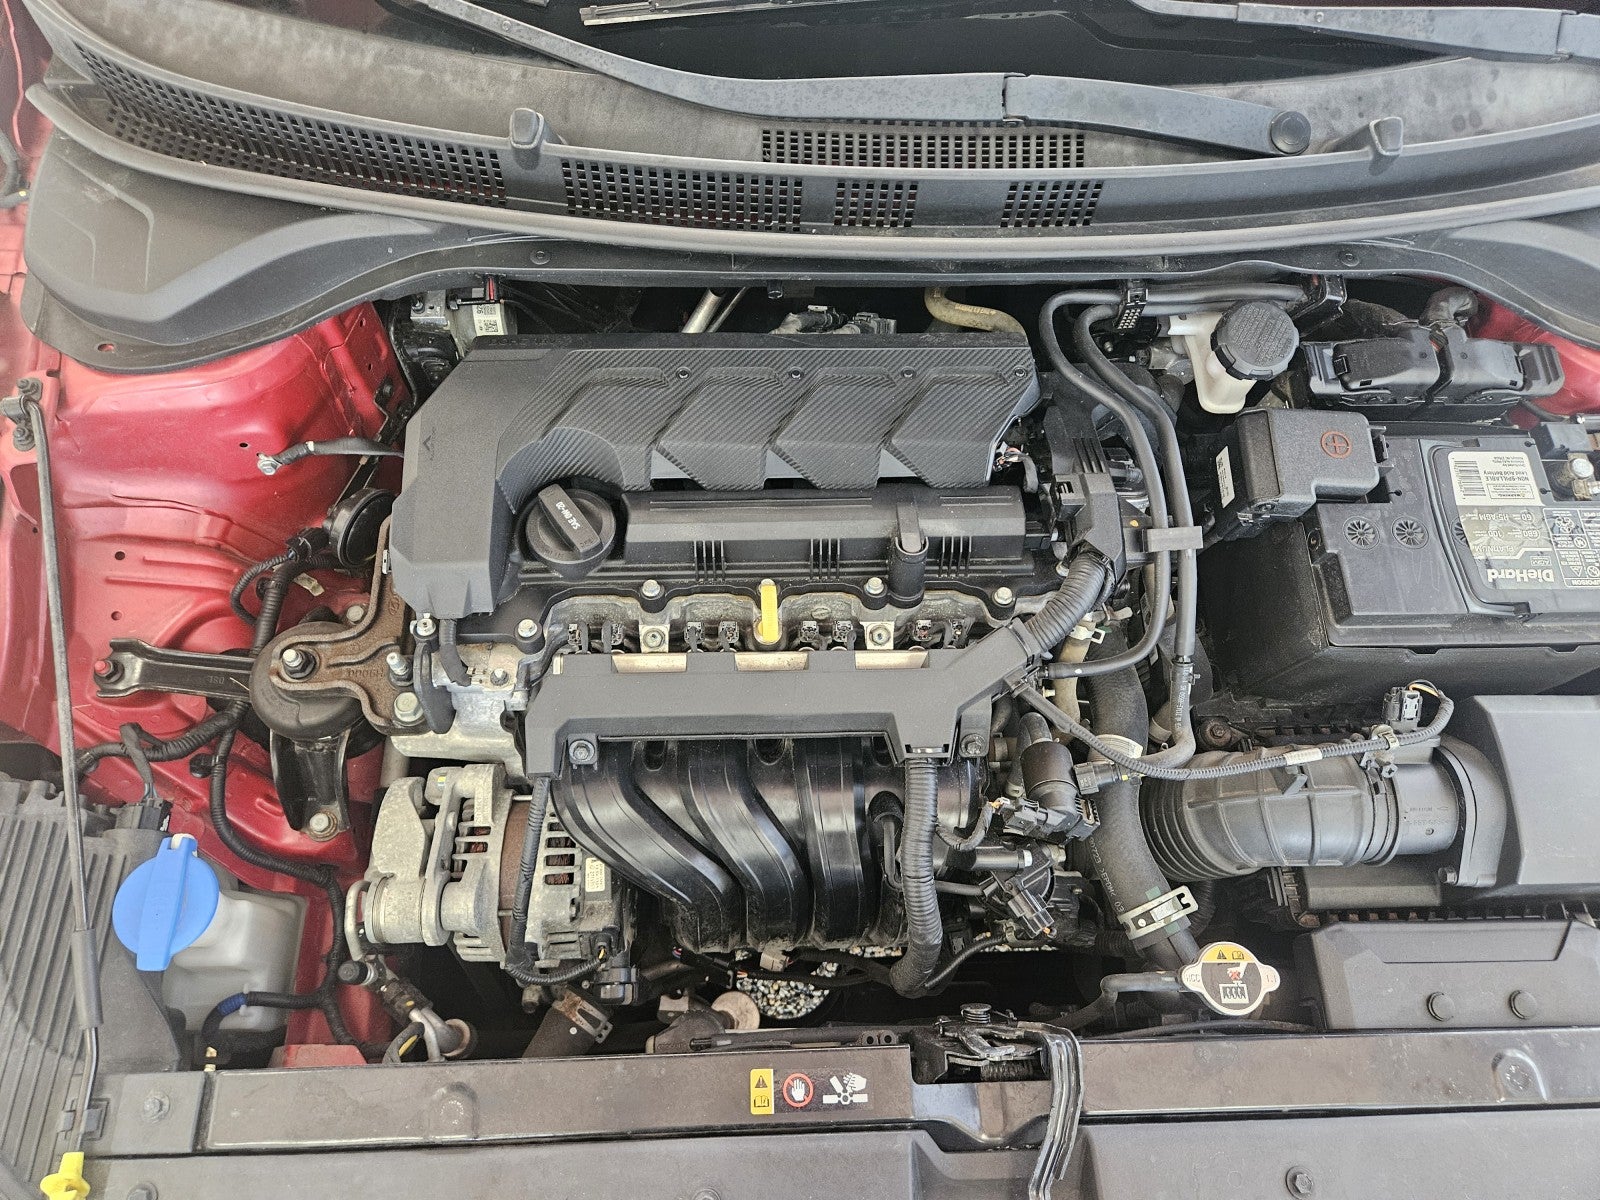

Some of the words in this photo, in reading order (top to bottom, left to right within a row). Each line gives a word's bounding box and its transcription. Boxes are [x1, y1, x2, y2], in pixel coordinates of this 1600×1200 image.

[1520, 513, 1532, 521] 60
[567, 517, 581, 530] SAE
[1487, 530, 1502, 538] 100
[1522, 530, 1538, 538] 680
[1486, 568, 1555, 583] DieHard
